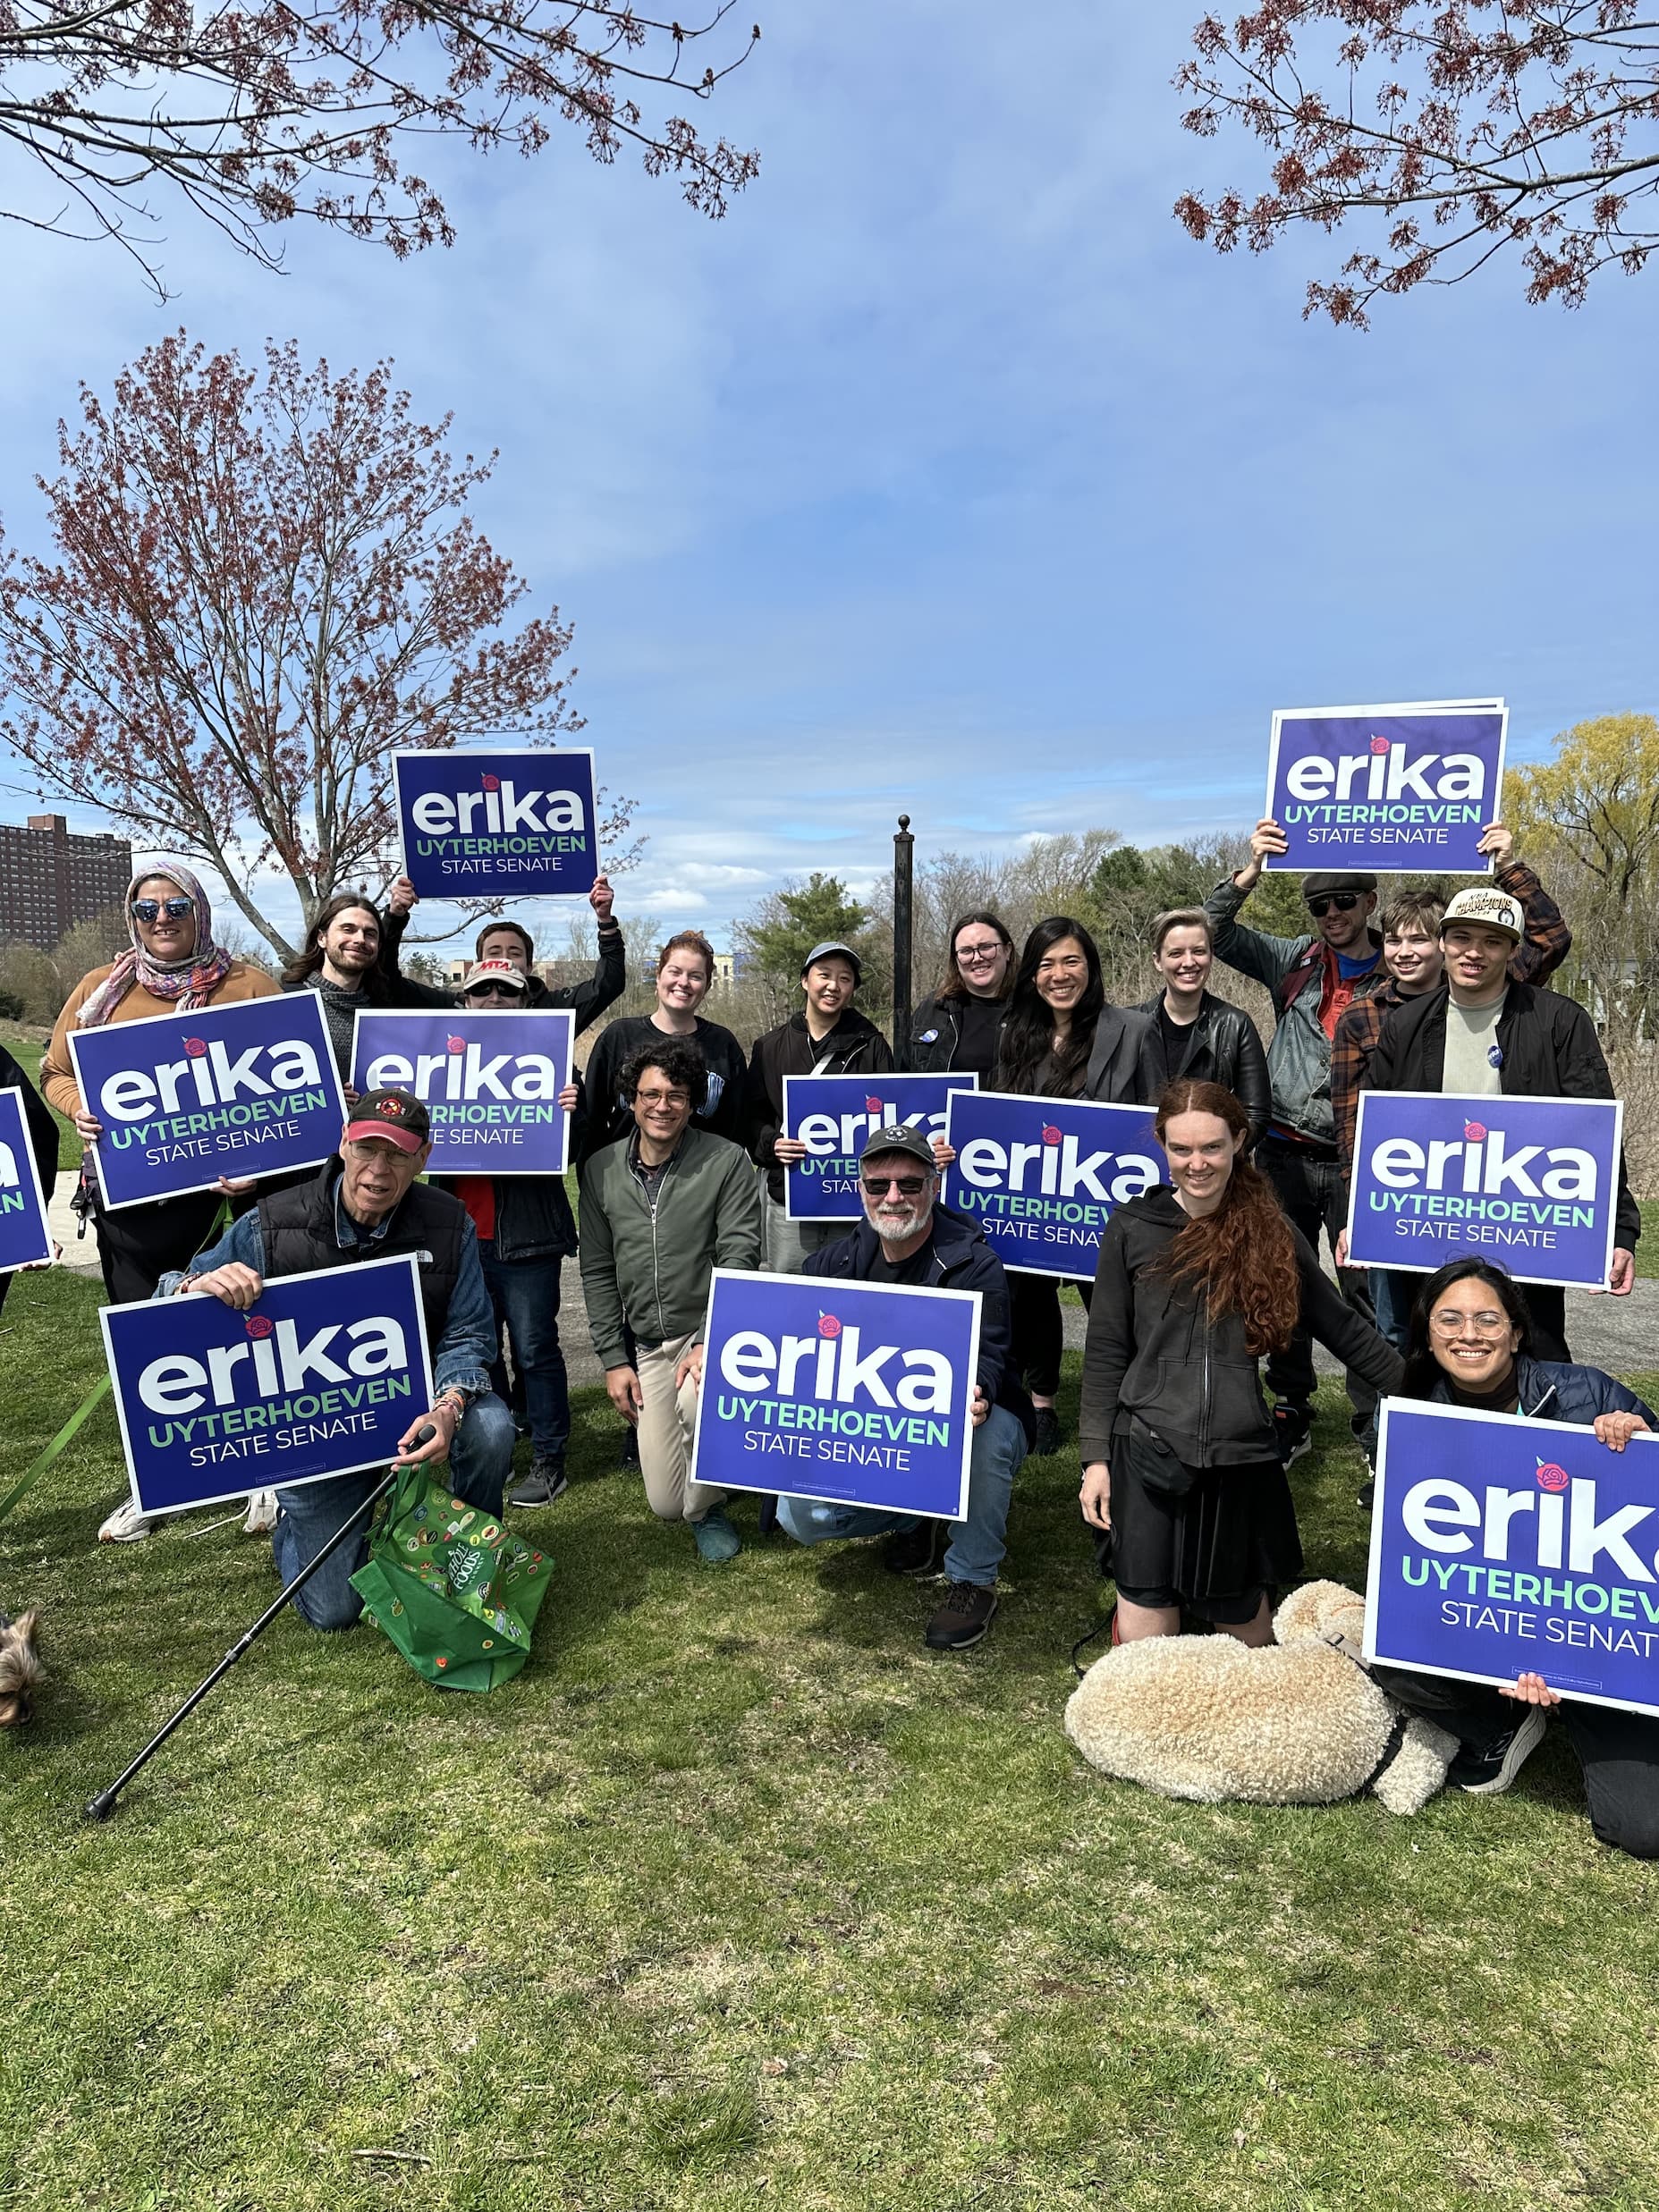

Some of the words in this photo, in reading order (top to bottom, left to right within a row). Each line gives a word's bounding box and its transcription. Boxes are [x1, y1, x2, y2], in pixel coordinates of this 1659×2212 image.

[1286, 737, 1485, 801] erika
[411, 775, 585, 835] erika
[1284, 805, 1481, 823] UYTERHOEVEN
[416, 836, 587, 857] UYTERHOEVEN
[1307, 828, 1366, 844] STATE
[1369, 828, 1449, 844] SENATE
[442, 859, 493, 874] STATE
[495, 857, 563, 873] SENATE
[100, 1038, 322, 1122] erika
[366, 1037, 555, 1101] erika
[110, 1089, 327, 1150] UYTERHOEVEN
[425, 1105, 553, 1124] RHOEVEN
[449, 1129, 524, 1144] SENATE
[145, 1137, 213, 1166] STATE
[216, 1119, 301, 1152] SENATE
[959, 1125, 1160, 1204] erika
[1371, 1123, 1597, 1202] erika
[821, 1179, 859, 1194] STAT
[1369, 1192, 1595, 1228] UYTERHOEVEN
[982, 1218, 1039, 1240] STATE
[1044, 1226, 1104, 1248] SENA
[1394, 1219, 1460, 1241] STATE
[1466, 1225, 1557, 1249] SENATE
[138, 1315, 409, 1415] erika
[720, 1315, 953, 1414] erika
[148, 1374, 411, 1448] UYTERHOEVEN
[717, 1395, 950, 1448] UYTERHOEVEN
[190, 1434, 270, 1466] STATE
[276, 1411, 377, 1449] SENATE
[743, 1431, 812, 1458] STATE
[817, 1439, 911, 1471] SENATE
[1401, 1464, 1659, 1583] erik
[448, 1542, 470, 1581] WHOLE
[453, 1551, 480, 1590] FOODS
[1401, 1556, 1659, 1624] UYTERHOEV
[1441, 1600, 1536, 1639] STATE
[1545, 1617, 1659, 1658] SENAT
